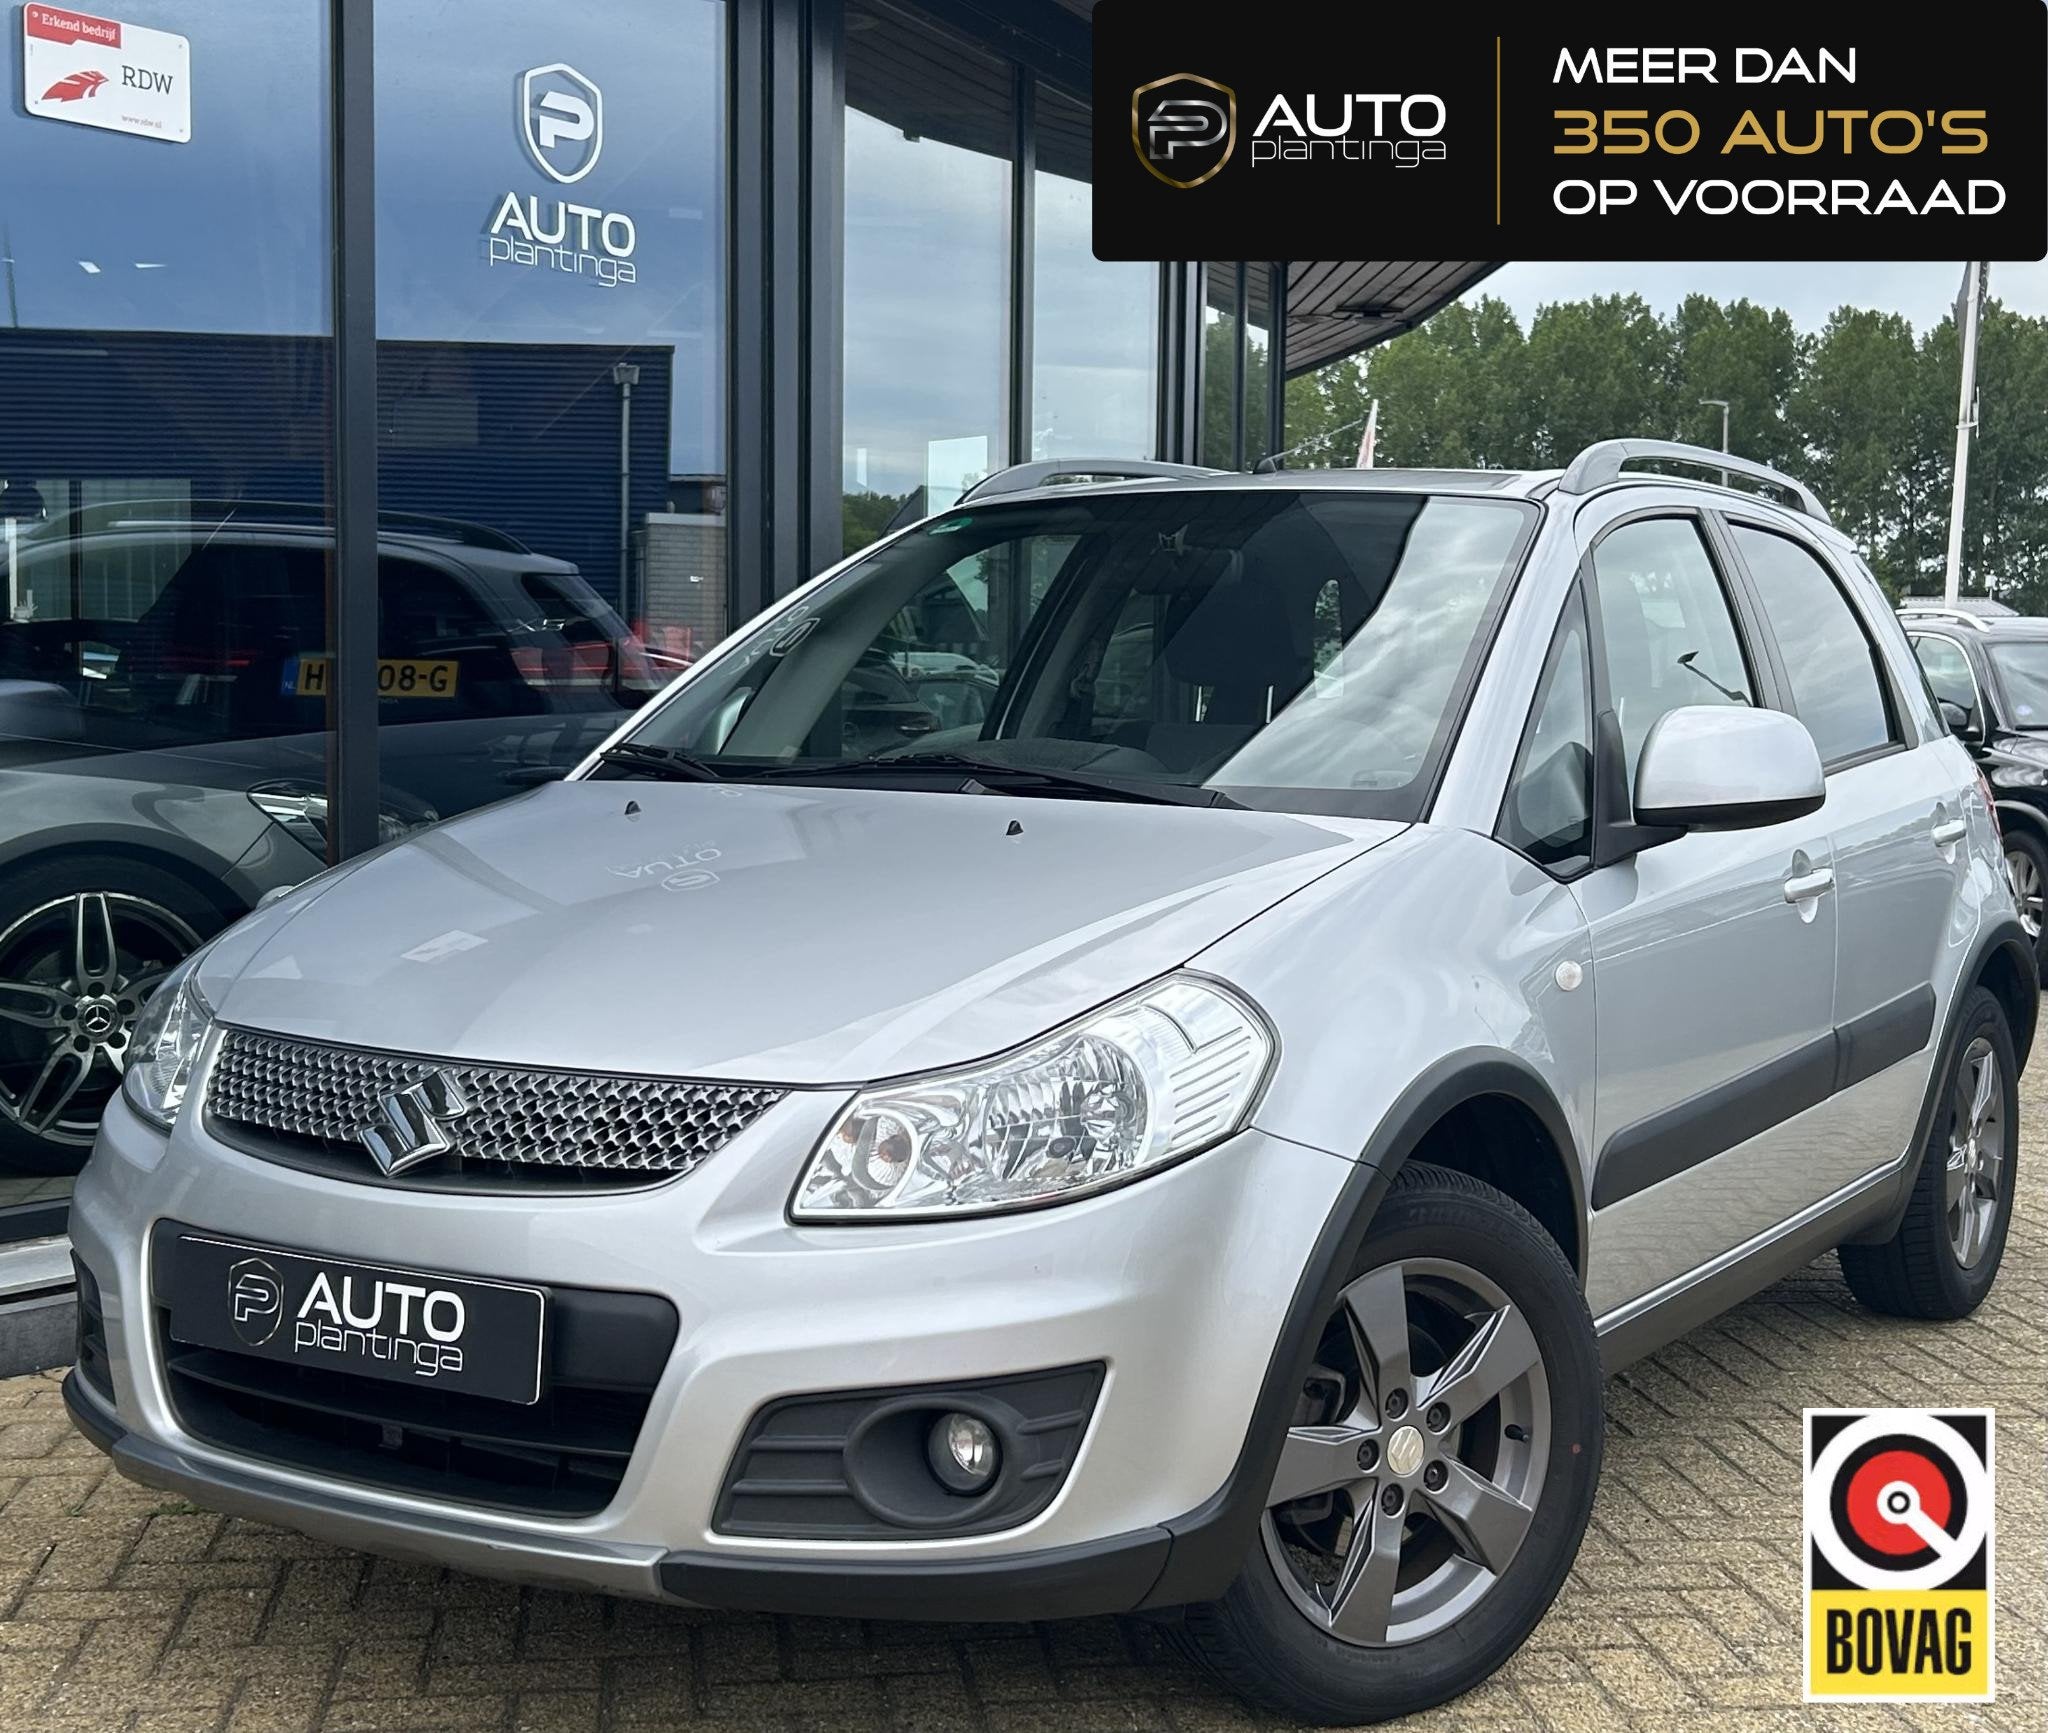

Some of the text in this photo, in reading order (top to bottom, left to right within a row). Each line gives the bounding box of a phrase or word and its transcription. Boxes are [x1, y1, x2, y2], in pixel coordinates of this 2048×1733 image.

[41, 13, 116, 42] Erkend bedrijf
[121, 65, 173, 95] RDW
[490, 191, 636, 258] AUTO
[489, 235, 636, 288] plantinga
[297, 1271, 466, 1342] AUTO
[294, 1318, 464, 1377] plantinga
